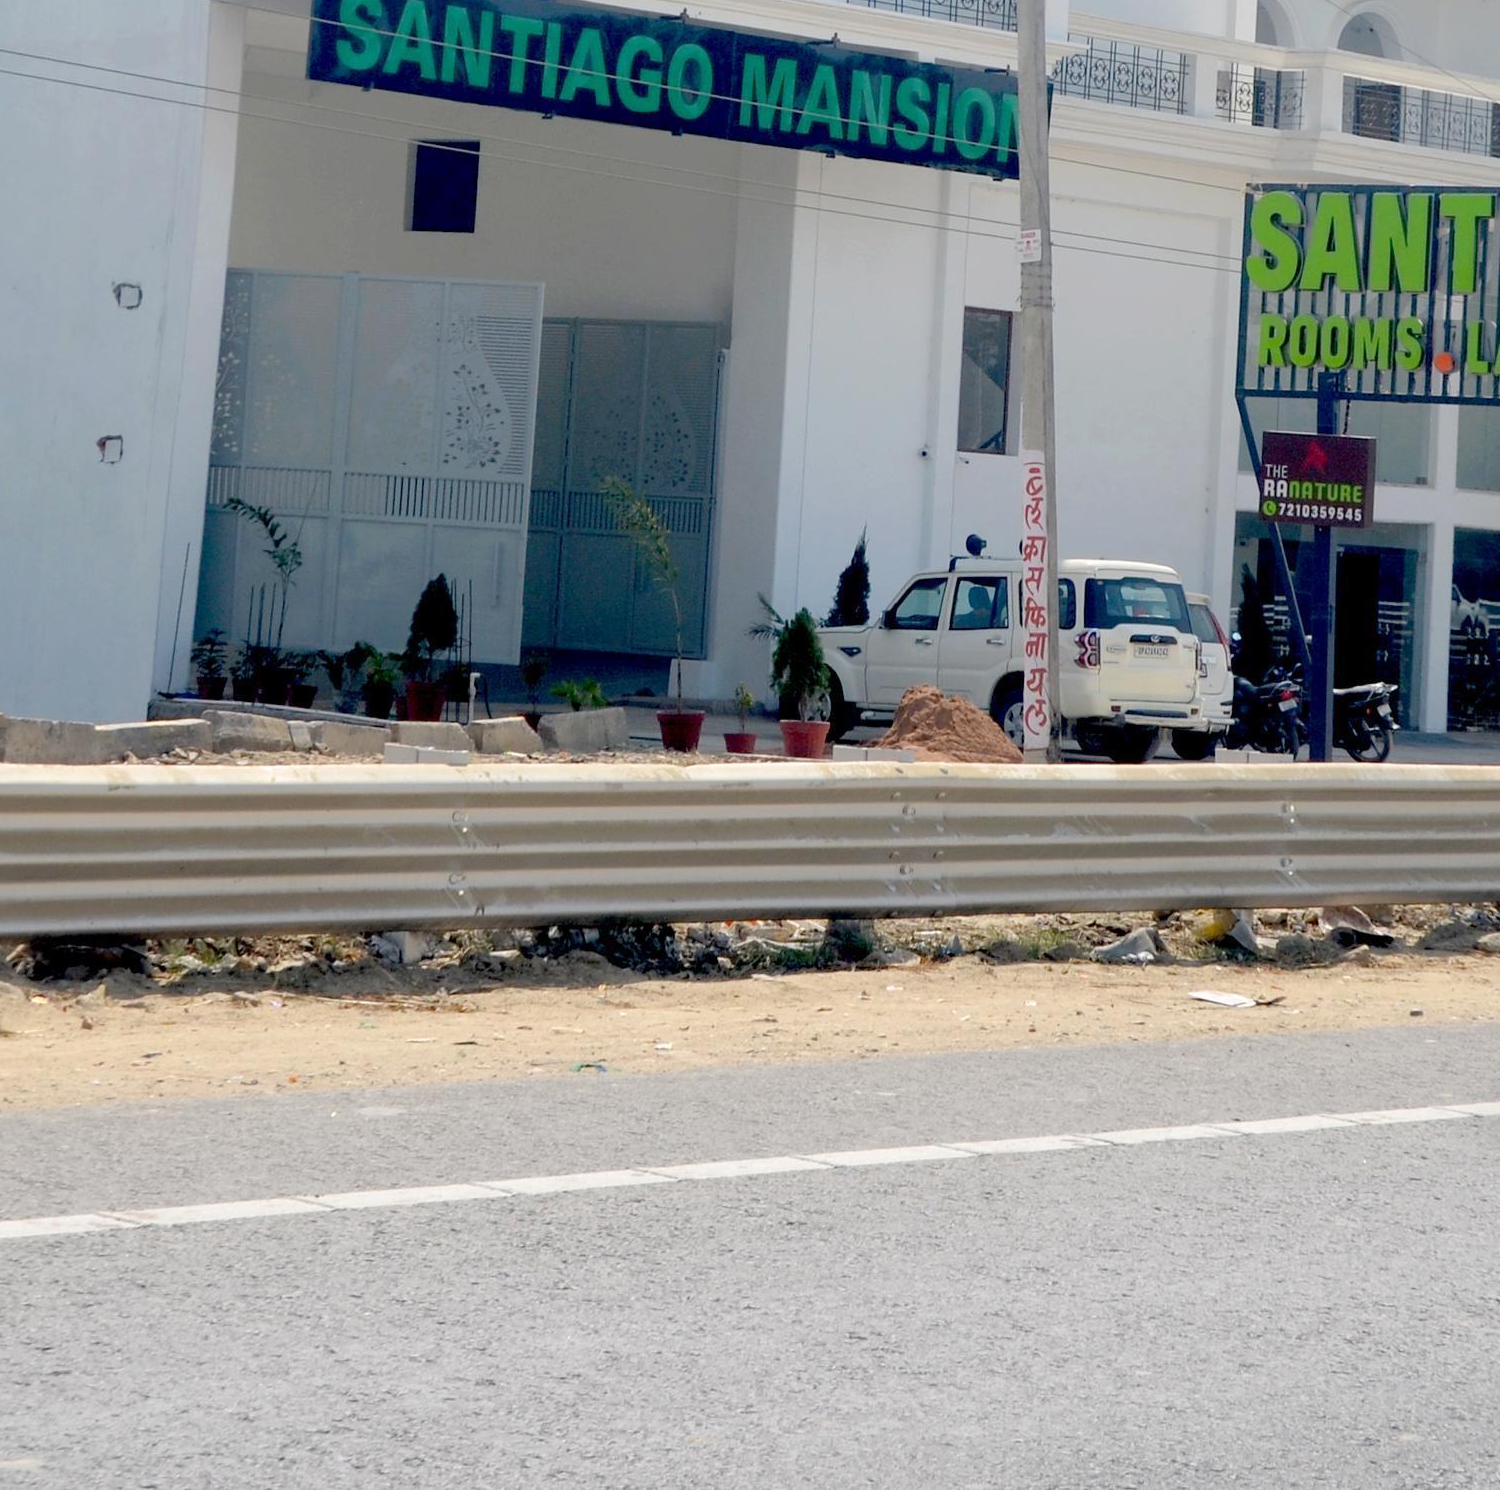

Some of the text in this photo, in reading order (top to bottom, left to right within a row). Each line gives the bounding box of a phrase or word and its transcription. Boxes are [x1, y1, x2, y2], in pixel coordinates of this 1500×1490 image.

[1258, 313, 1424, 372] ROOMS
[1264, 464, 1288, 479] THE
[1279, 503, 1362, 522] 7210359545
